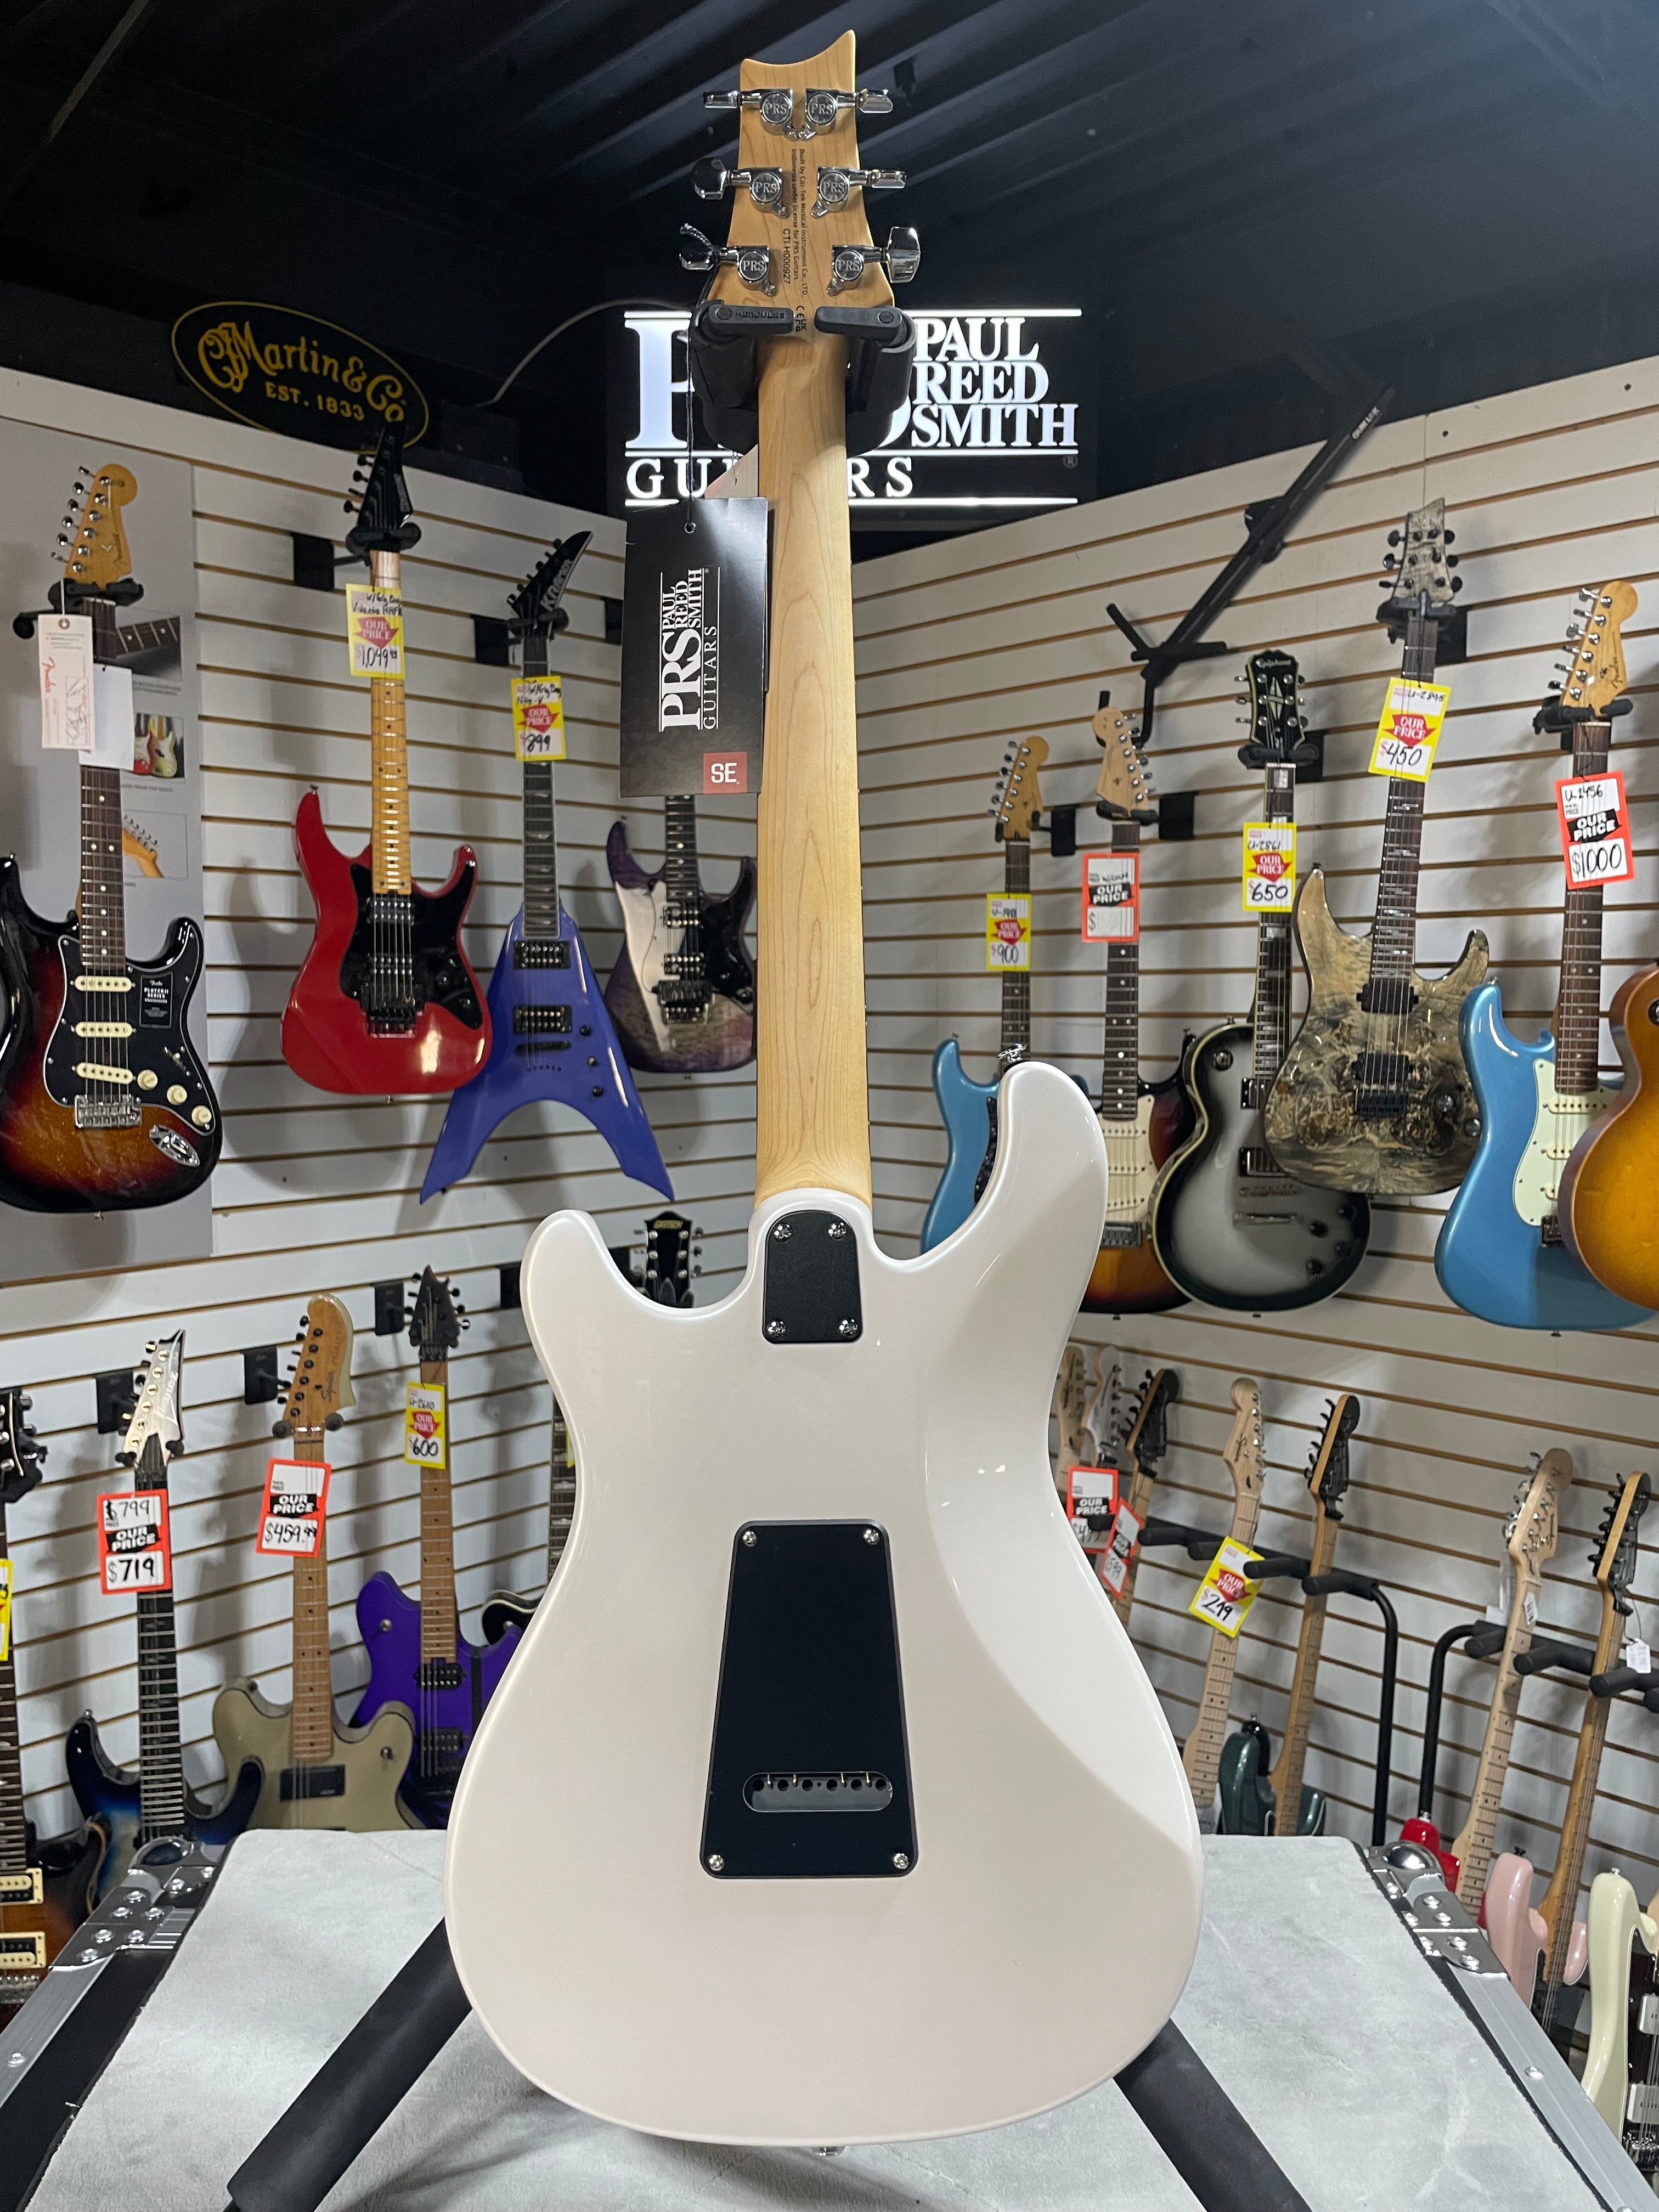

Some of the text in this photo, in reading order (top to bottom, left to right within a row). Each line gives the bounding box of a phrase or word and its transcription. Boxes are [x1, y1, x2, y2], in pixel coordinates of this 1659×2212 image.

[765, 103, 787, 114] PRS
[811, 103, 833, 114] PRS
[756, 182, 777, 194] PRS
[821, 182, 844, 194] PRS
[743, 260, 764, 271] PRS
[839, 259, 861, 271] PRS
[915, 318, 1039, 362] PAUL
[913, 361, 1049, 405] REED
[265, 382, 365, 422] EST. 1833
[911, 403, 1079, 448] SMITH
[626, 458, 913, 499] GURS
[675, 580, 689, 629] REED
[688, 568, 702, 629] SMITH
[663, 586, 675, 628] PAUL
[662, 629, 701, 730] PRS
[703, 625, 718, 730] GUITARS
[1400, 716, 1424, 729] OUR
[1394, 725, 1426, 740] PRICE
[710, 763, 737, 784] SE
[1577, 812, 1607, 830] OUR
[1573, 820, 1616, 842] PRICE
[1260, 855, 1281, 865] OUR
[1571, 844, 1622, 878] $1000
[1256, 864, 1284, 875] PRICE
[1097, 884, 1123, 895] OUR
[1093, 891, 1129, 905] PRICE
[278, 1495, 308, 1504] OUR
[1079, 1497, 1103, 1506] OUR
[272, 1503, 315, 1515] PRICE
[1075, 1504, 1108, 1515] PRICE
[116, 1526, 148, 1540] OUR
[111, 1533, 156, 1552] PRICE
